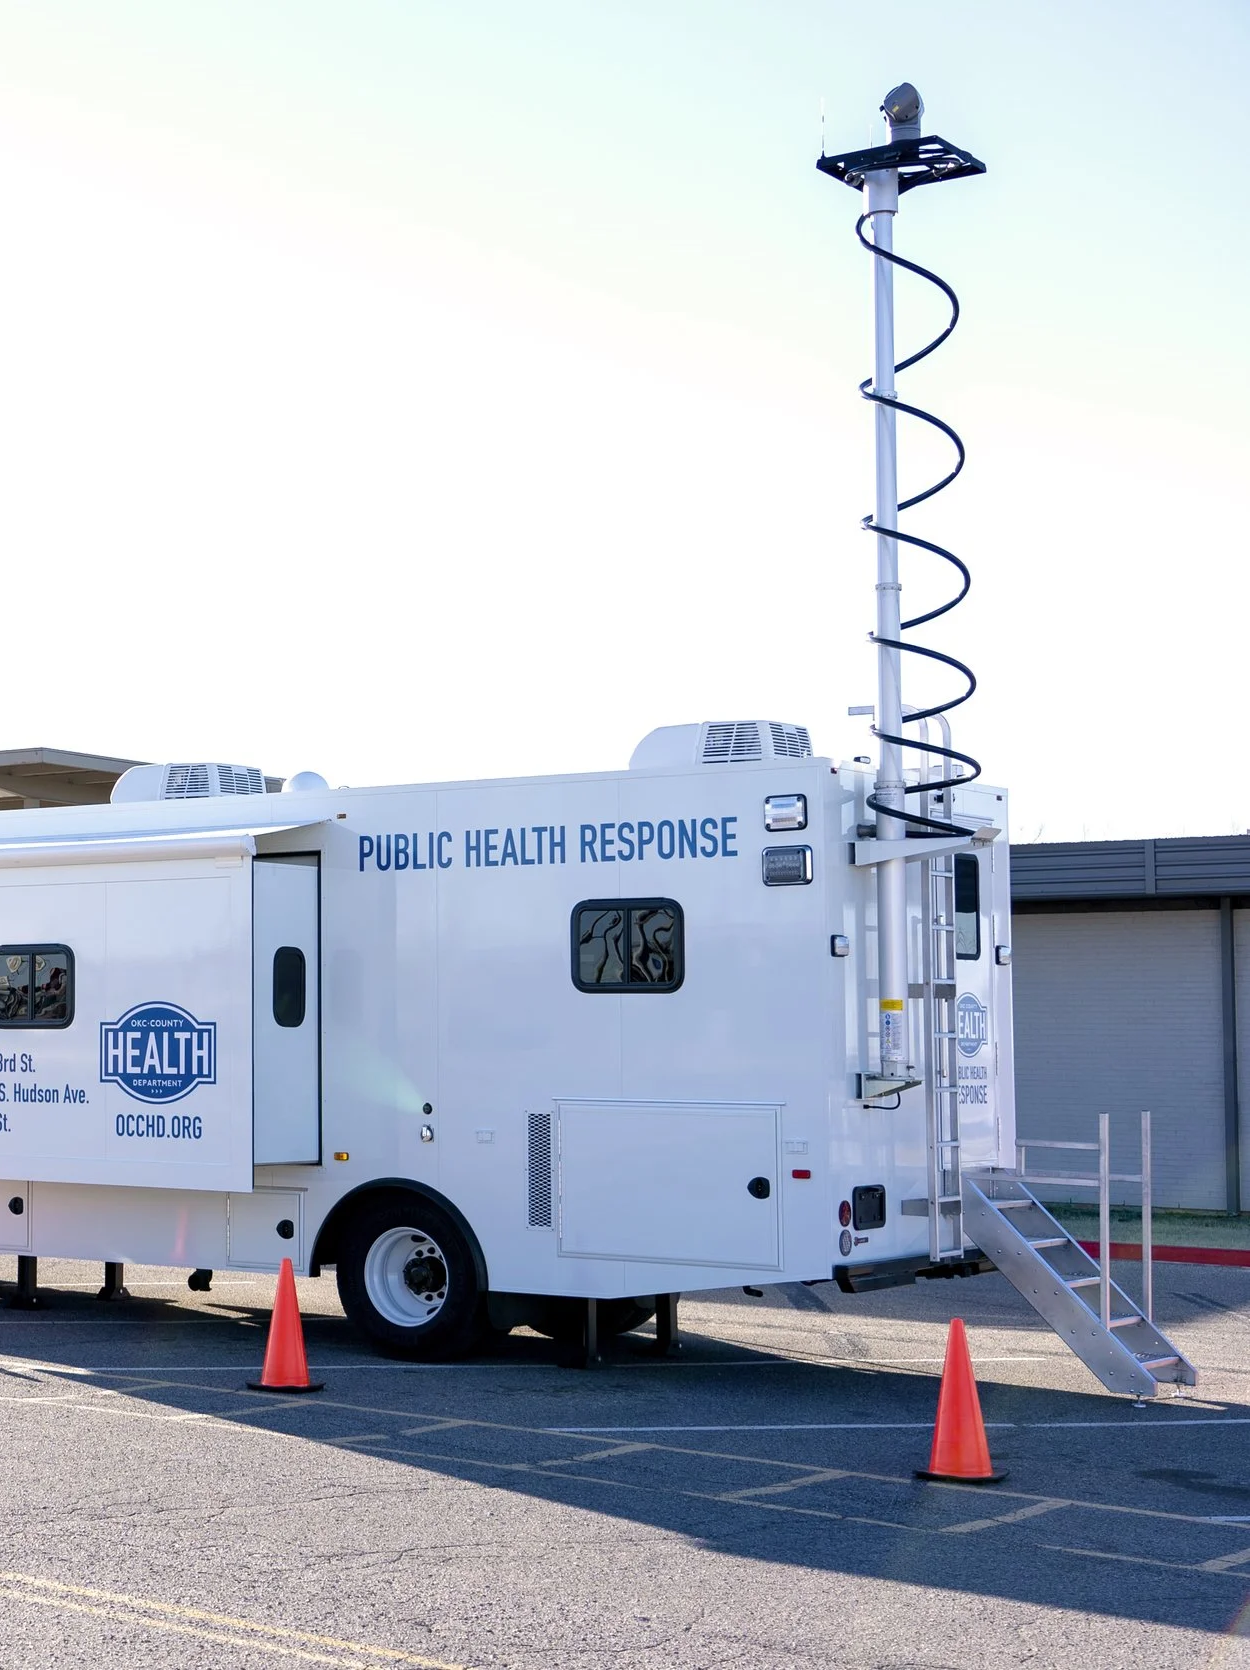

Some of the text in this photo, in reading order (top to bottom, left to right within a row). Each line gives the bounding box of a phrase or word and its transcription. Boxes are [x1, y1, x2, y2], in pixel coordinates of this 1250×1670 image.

[359, 816, 739, 872] PUBLIC HEALTH RESPONSE
[957, 1011, 987, 1039] EALTH
[20, 1053, 36, 1073] St.
[107, 1031, 209, 1075] HEALTH
[132, 1079, 183, 1087] DEPARTMENT
[970, 1065, 988, 1080] HEALTH
[13, 1083, 59, 1104] Hudson
[63, 1083, 90, 1104] Ave.
[115, 1113, 202, 1140] OCCHD.ORG
